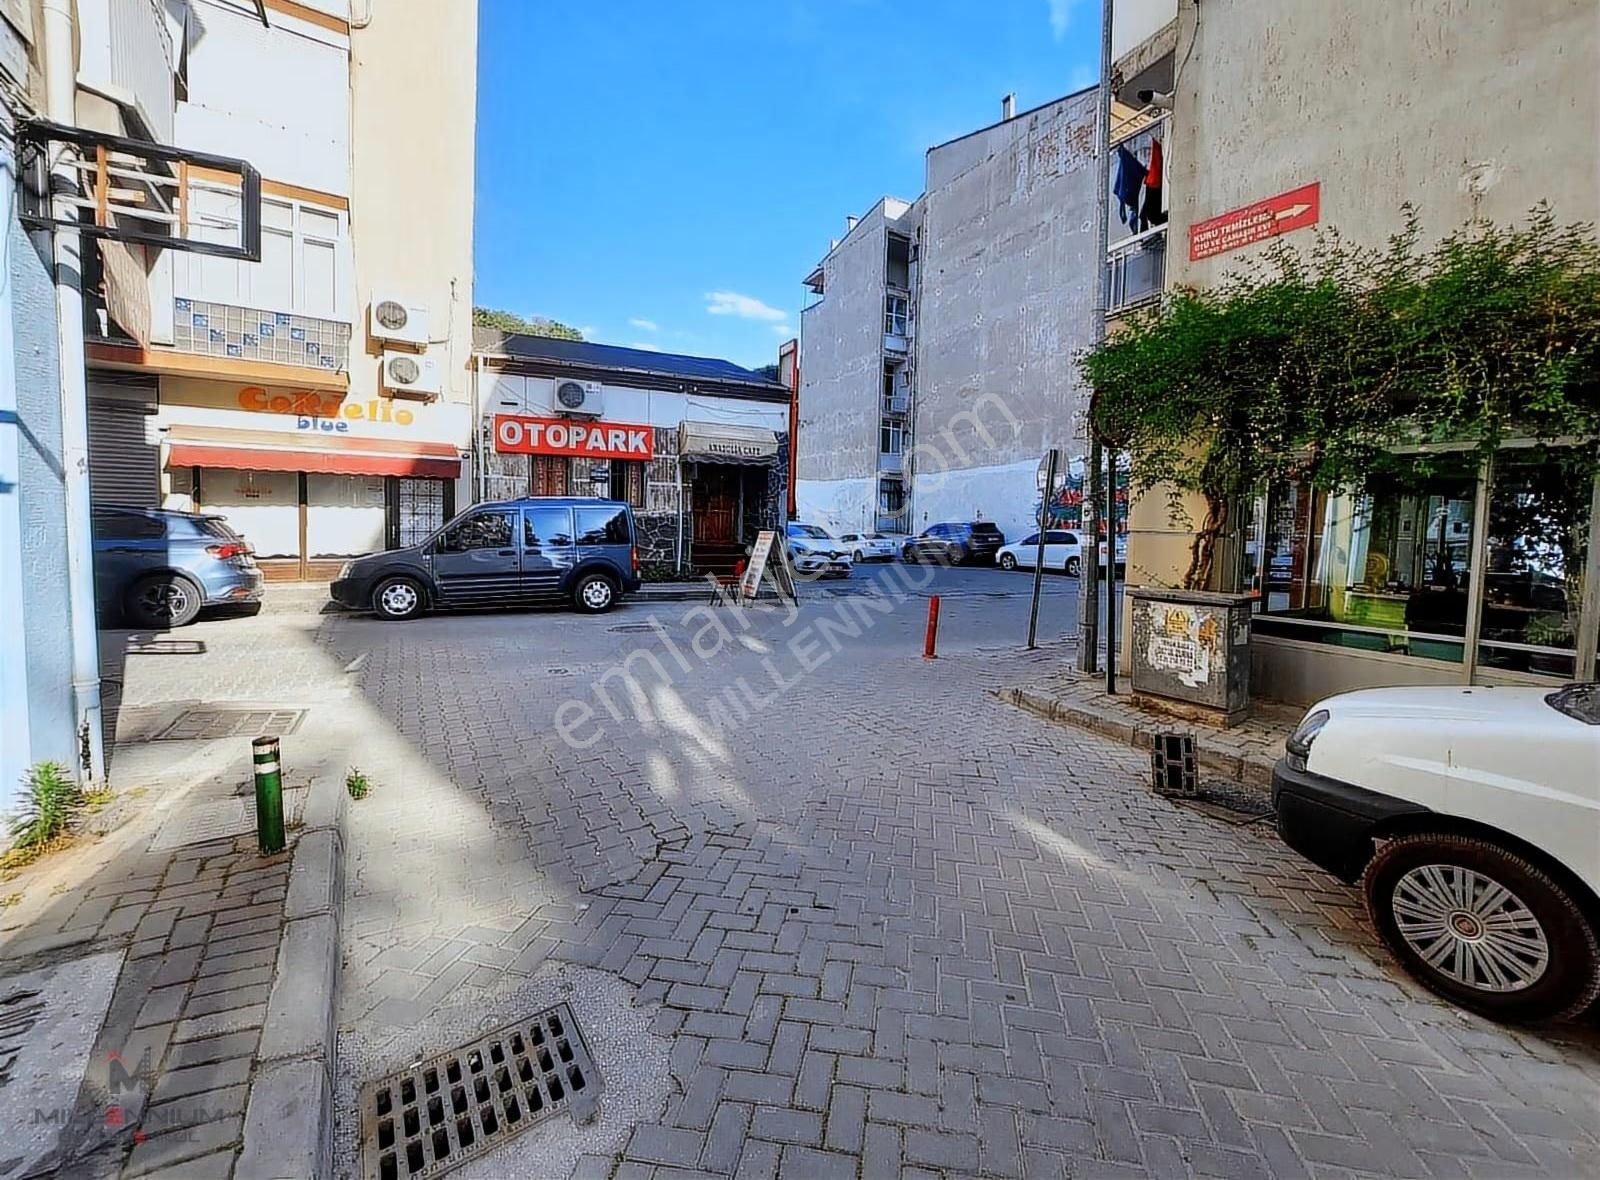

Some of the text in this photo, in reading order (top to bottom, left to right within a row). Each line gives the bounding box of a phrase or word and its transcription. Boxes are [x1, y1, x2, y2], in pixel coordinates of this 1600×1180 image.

[1194, 228, 1219, 244] KURU
[297, 415, 349, 432] blue
[499, 420, 649, 455] OTOPARK
